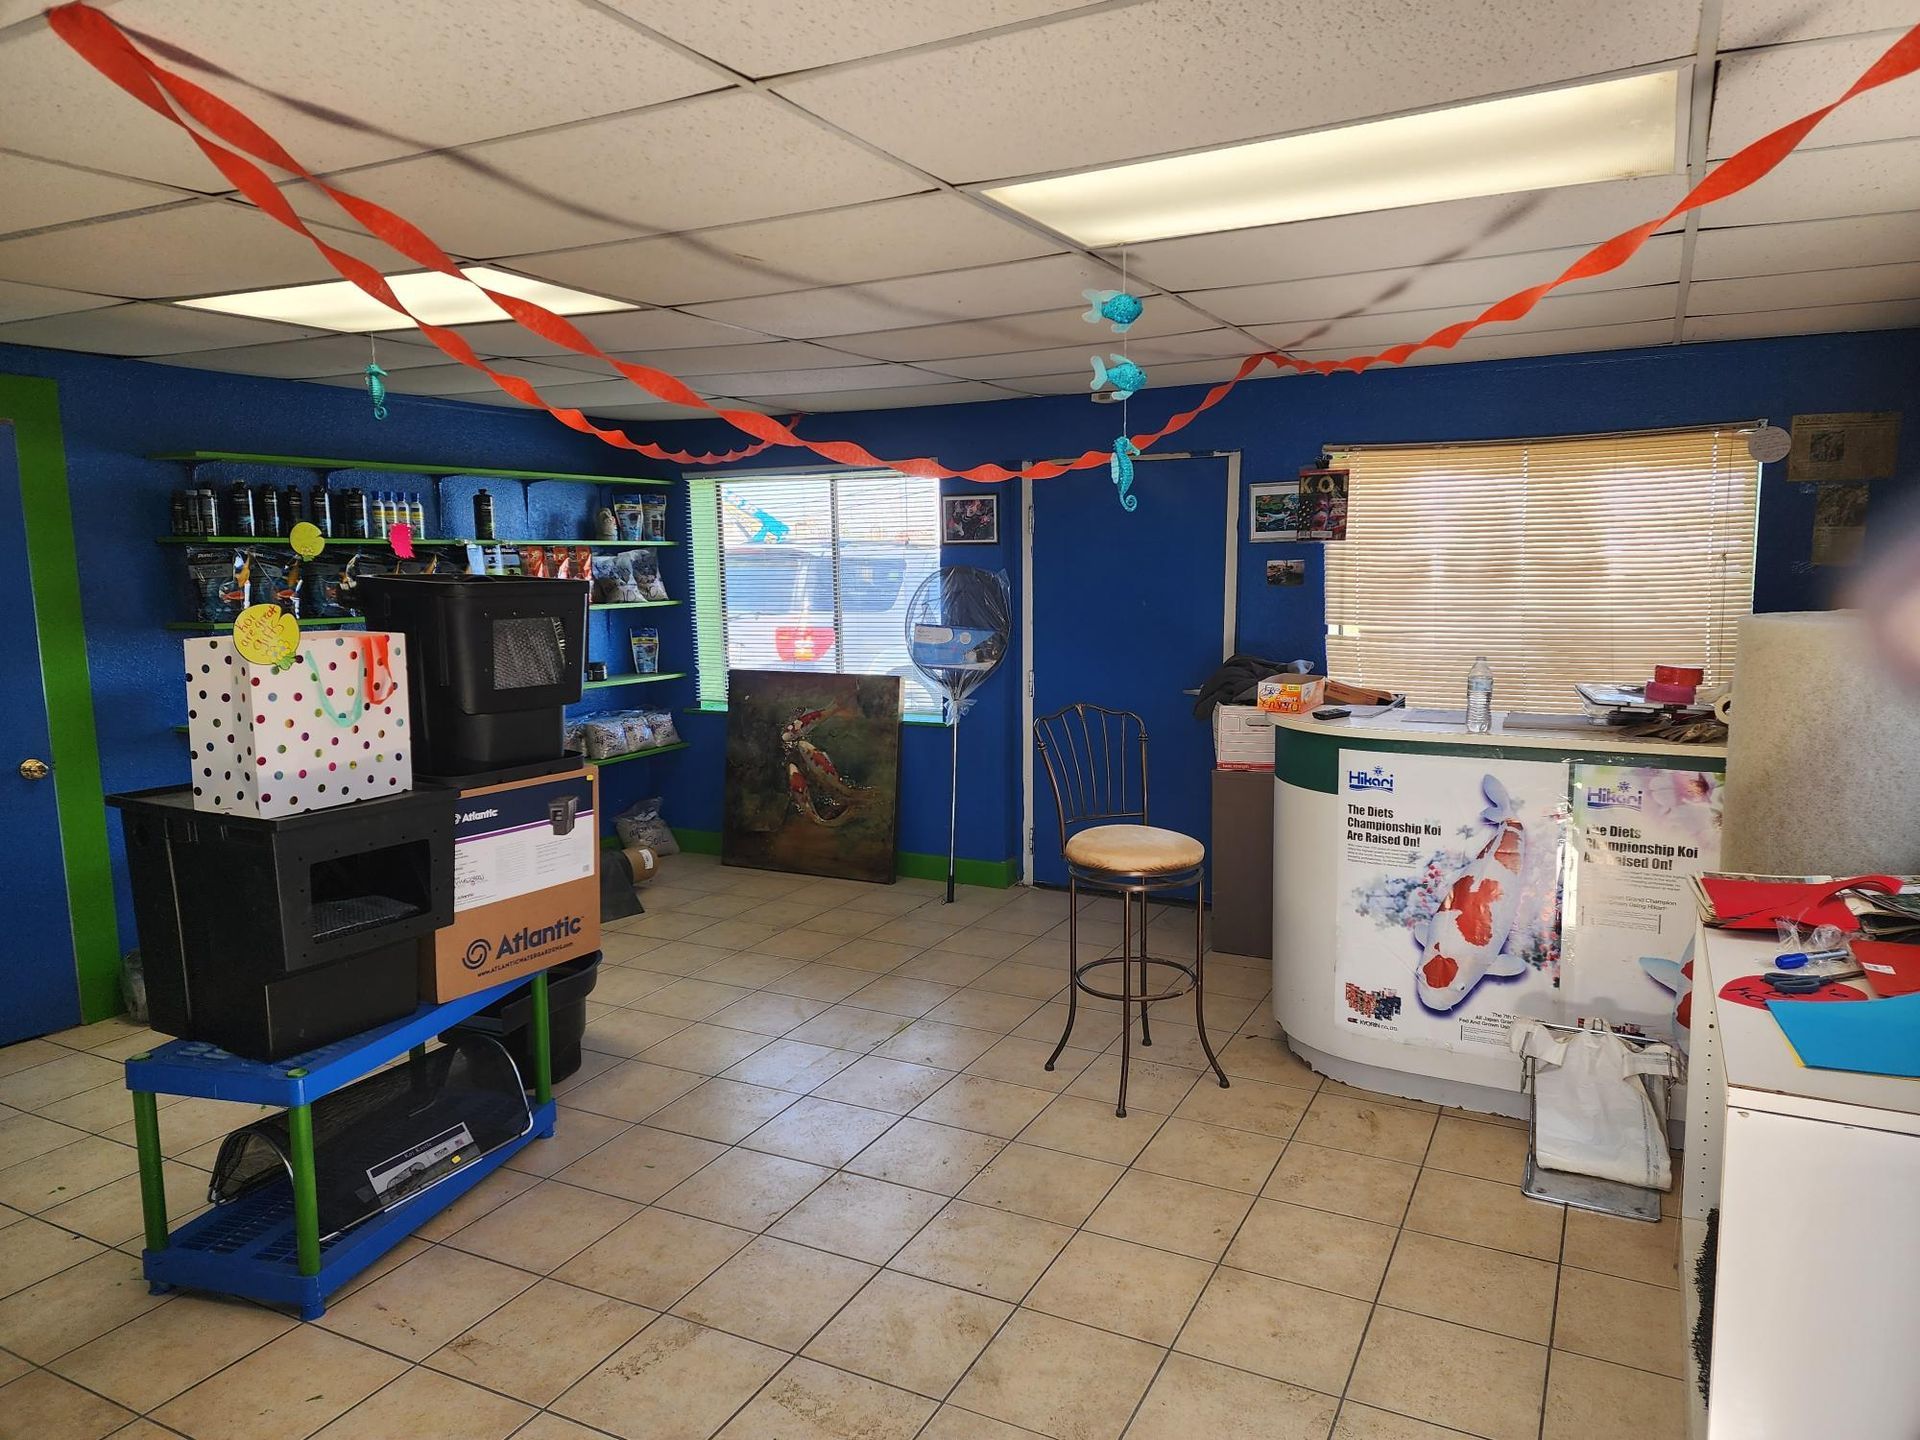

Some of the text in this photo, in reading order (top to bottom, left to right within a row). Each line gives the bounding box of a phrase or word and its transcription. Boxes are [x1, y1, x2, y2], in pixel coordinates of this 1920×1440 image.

[1300, 475, 1348, 493] KOI
[1349, 771, 1394, 788] Hikari
[1587, 787, 1643, 805] Hikari
[461, 808, 499, 823] Atlantic
[1347, 804, 1394, 818] The Diets
[1347, 816, 1441, 836] Championship Koi
[1609, 825, 1642, 839] Diets
[1347, 829, 1421, 848] Are Raised On!
[1677, 845, 1699, 859] Koi
[1651, 858, 1673, 871] On!
[496, 915, 582, 959] Atlantic
